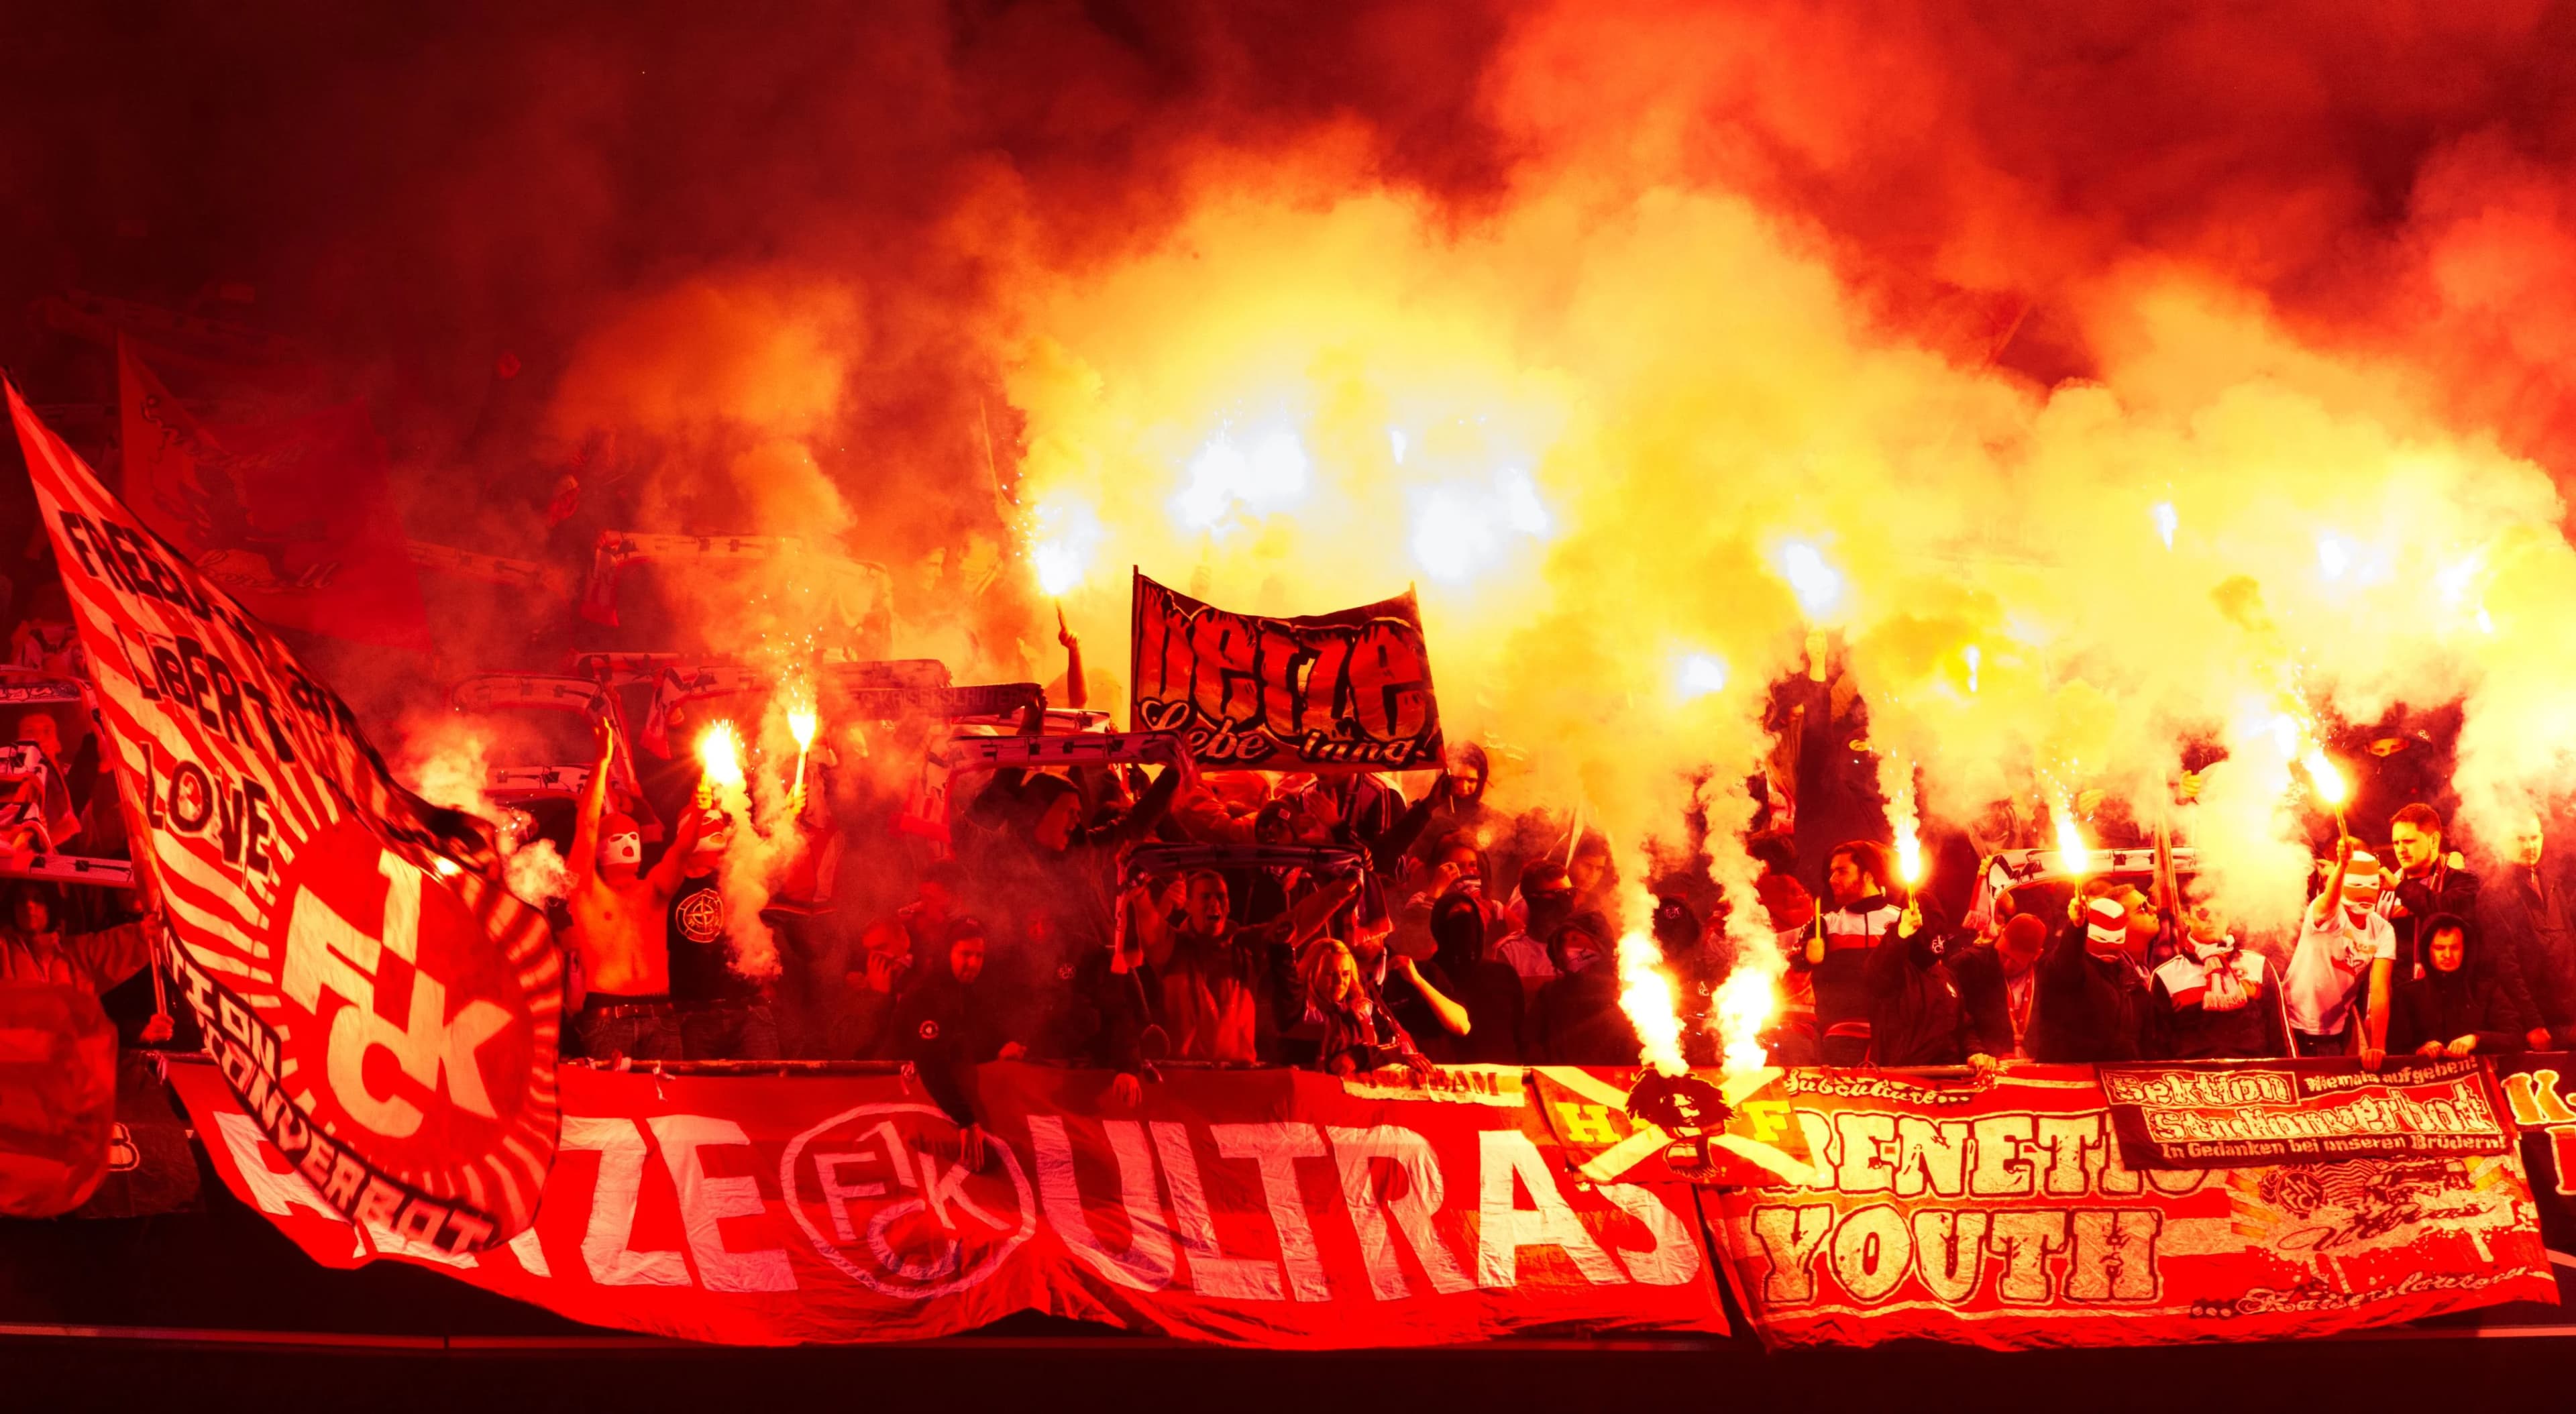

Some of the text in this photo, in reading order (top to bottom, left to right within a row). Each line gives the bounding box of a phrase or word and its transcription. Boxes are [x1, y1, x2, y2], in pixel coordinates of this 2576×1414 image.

[113, 624, 295, 763] LIBERT
[140, 741, 270, 877] LOVE
[2108, 1072, 2293, 1105] Sektion
[2304, 1056, 2479, 1092] Niemals aufgeben!
[2160, 1134, 2506, 1159] In Gedanken bei unseren Brüdern!
[1026, 1113, 1700, 1303] ULTRAS
[1752, 1204, 2163, 1305] YOUTH
